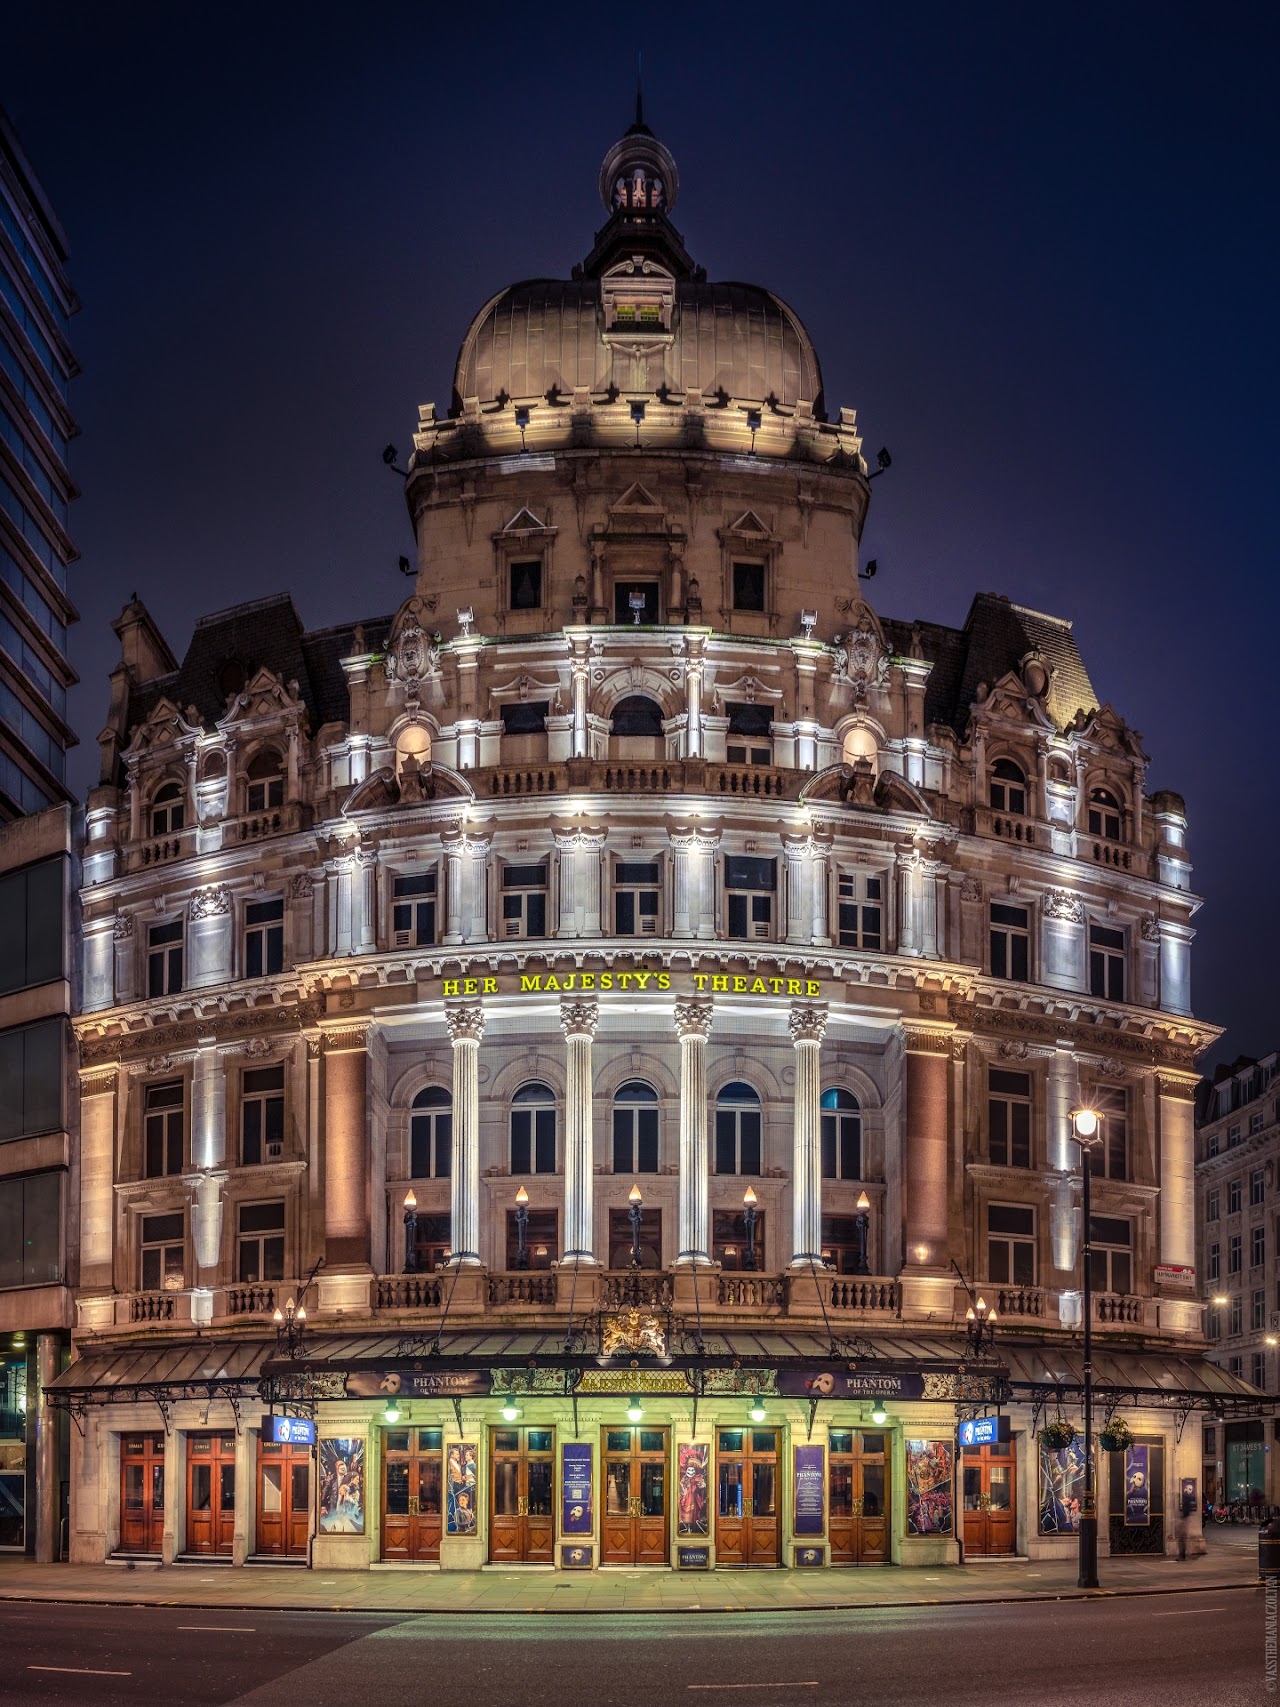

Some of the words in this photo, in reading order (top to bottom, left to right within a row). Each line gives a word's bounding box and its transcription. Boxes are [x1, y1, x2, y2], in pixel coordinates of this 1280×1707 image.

[442, 977, 499, 997] HER
[519, 971, 672, 992] MAJESTY'S
[693, 973, 821, 996] THEATRE
[1157, 1271, 1182, 1279] HAYMARKET
[413, 1376, 469, 1387] PHANTOM
[846, 1377, 902, 1390] PHANTOM
[1232, 1444, 1239, 1452] ST
